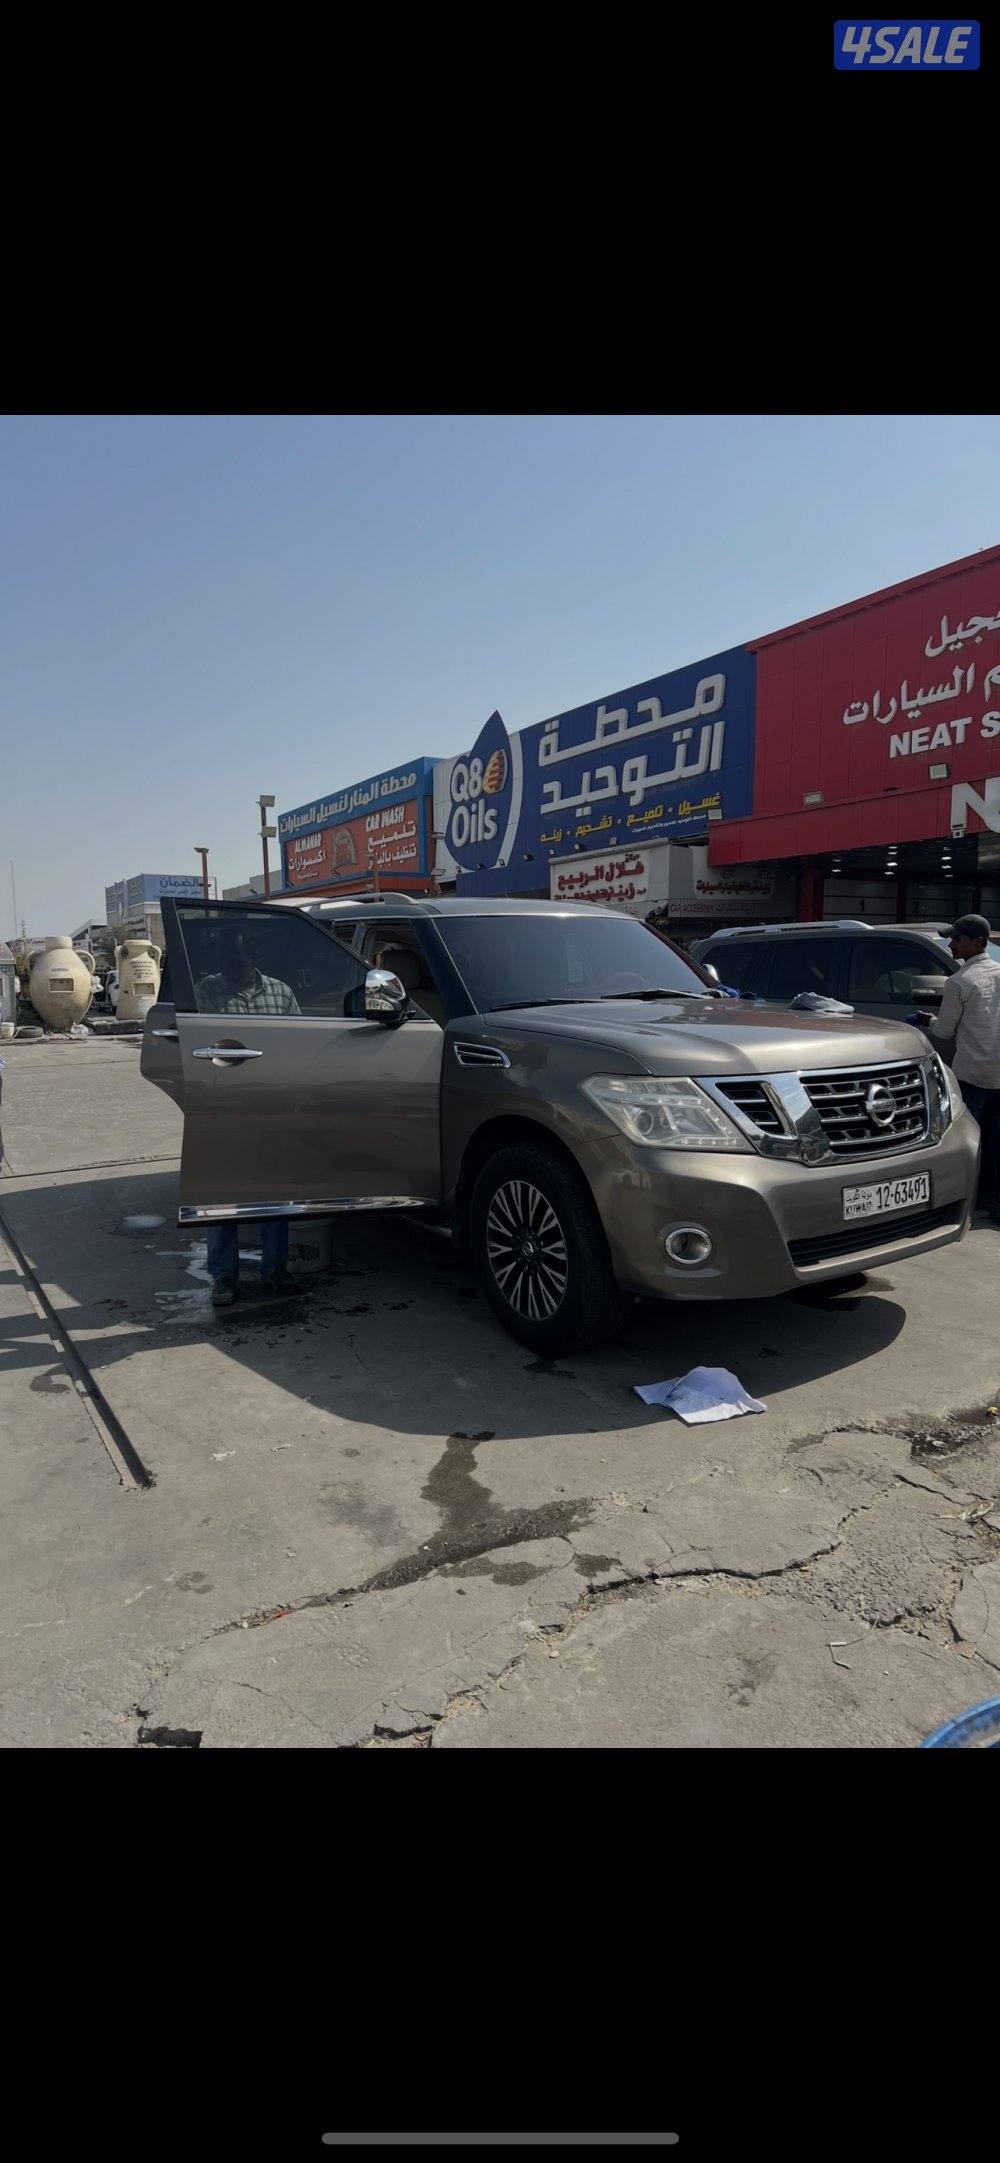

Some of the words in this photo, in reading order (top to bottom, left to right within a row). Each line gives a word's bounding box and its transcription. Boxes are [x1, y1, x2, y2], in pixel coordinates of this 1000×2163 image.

[925, 611, 1000, 658] جيل
[843, 662, 975, 725] السيارات
[538, 673, 726, 767] محطة
[889, 717, 973, 759] NEAT
[381, 773, 418, 795] محطة
[451, 757, 484, 802] Q8
[540, 720, 725, 817] التوحيد
[317, 793, 348, 824] لغسيل
[349, 782, 379, 812] المنار
[678, 792, 721, 816] غسيل
[280, 806, 317, 833] السيارات
[365, 813, 380, 832] CAR
[381, 805, 405, 828] WASH
[451, 799, 498, 847] Oils
[575, 814, 613, 838] تشحيم
[626, 804, 663, 827] تلميع
[368, 819, 417, 853] تلميع
[558, 864, 605, 891] الربيع
[846, 1202, 872, 1216] KUWAIT
[876, 1177, 928, 1210] 12-63491
